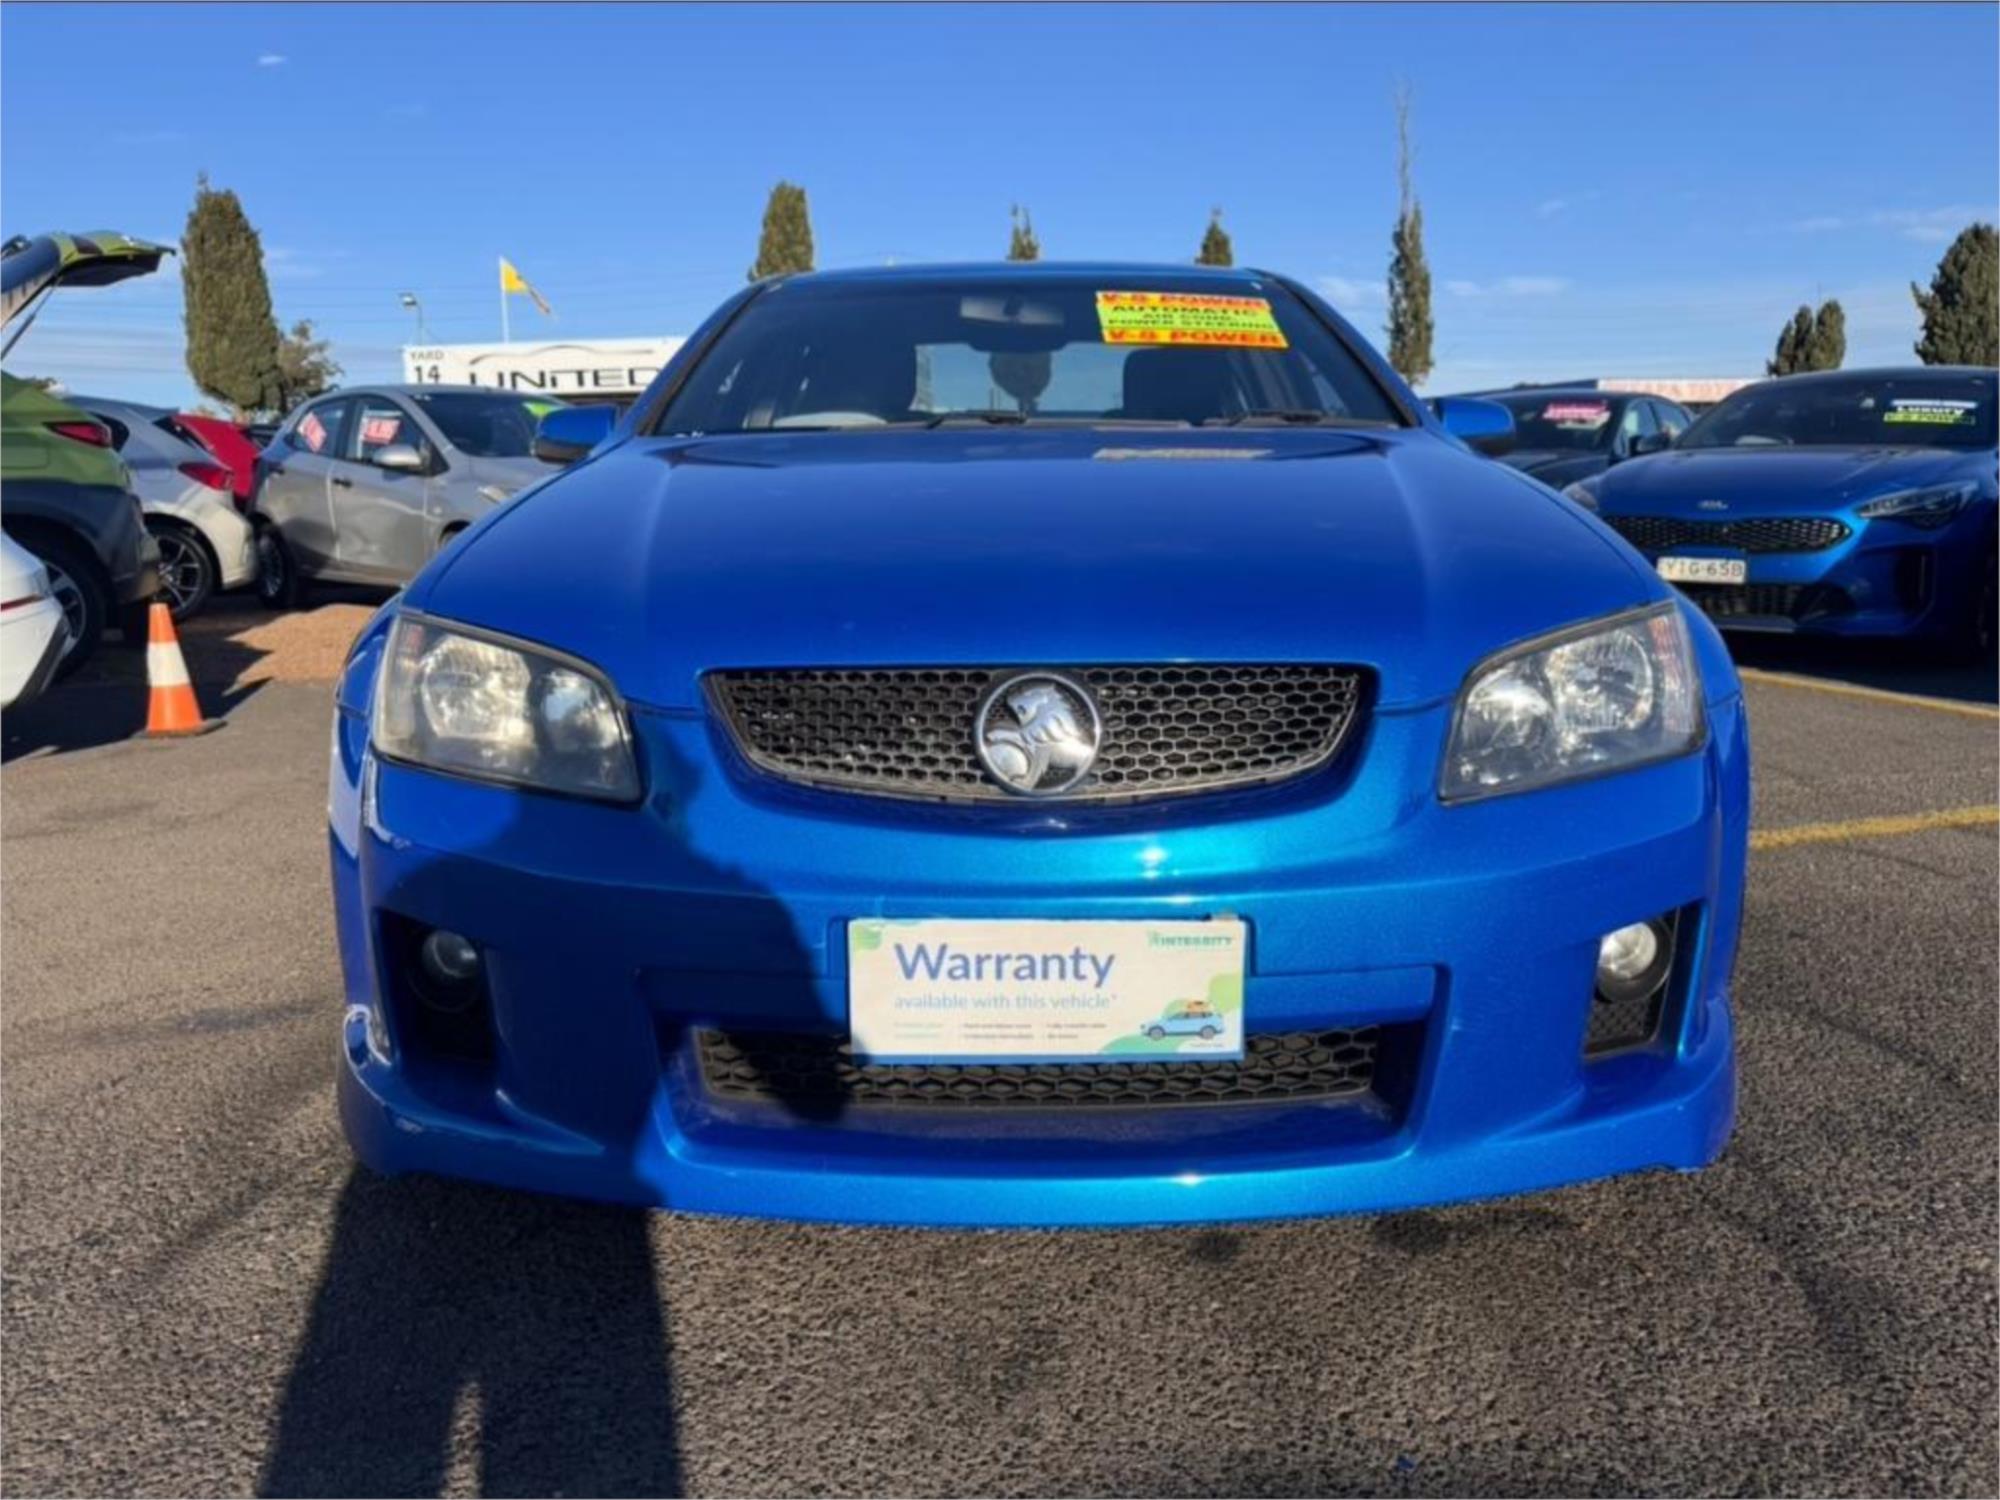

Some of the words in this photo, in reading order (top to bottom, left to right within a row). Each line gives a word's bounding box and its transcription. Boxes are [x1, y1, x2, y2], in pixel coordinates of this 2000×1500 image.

[1170, 331, 1279, 344] POWER
[410, 350, 445, 360] YARD
[414, 364, 442, 384] 14
[469, 367, 662, 388] UNITED
[894, 943, 1116, 988] Warranty
[895, 993, 967, 1009] available
[972, 993, 1010, 1009] with
[1016, 993, 1046, 1009] this
